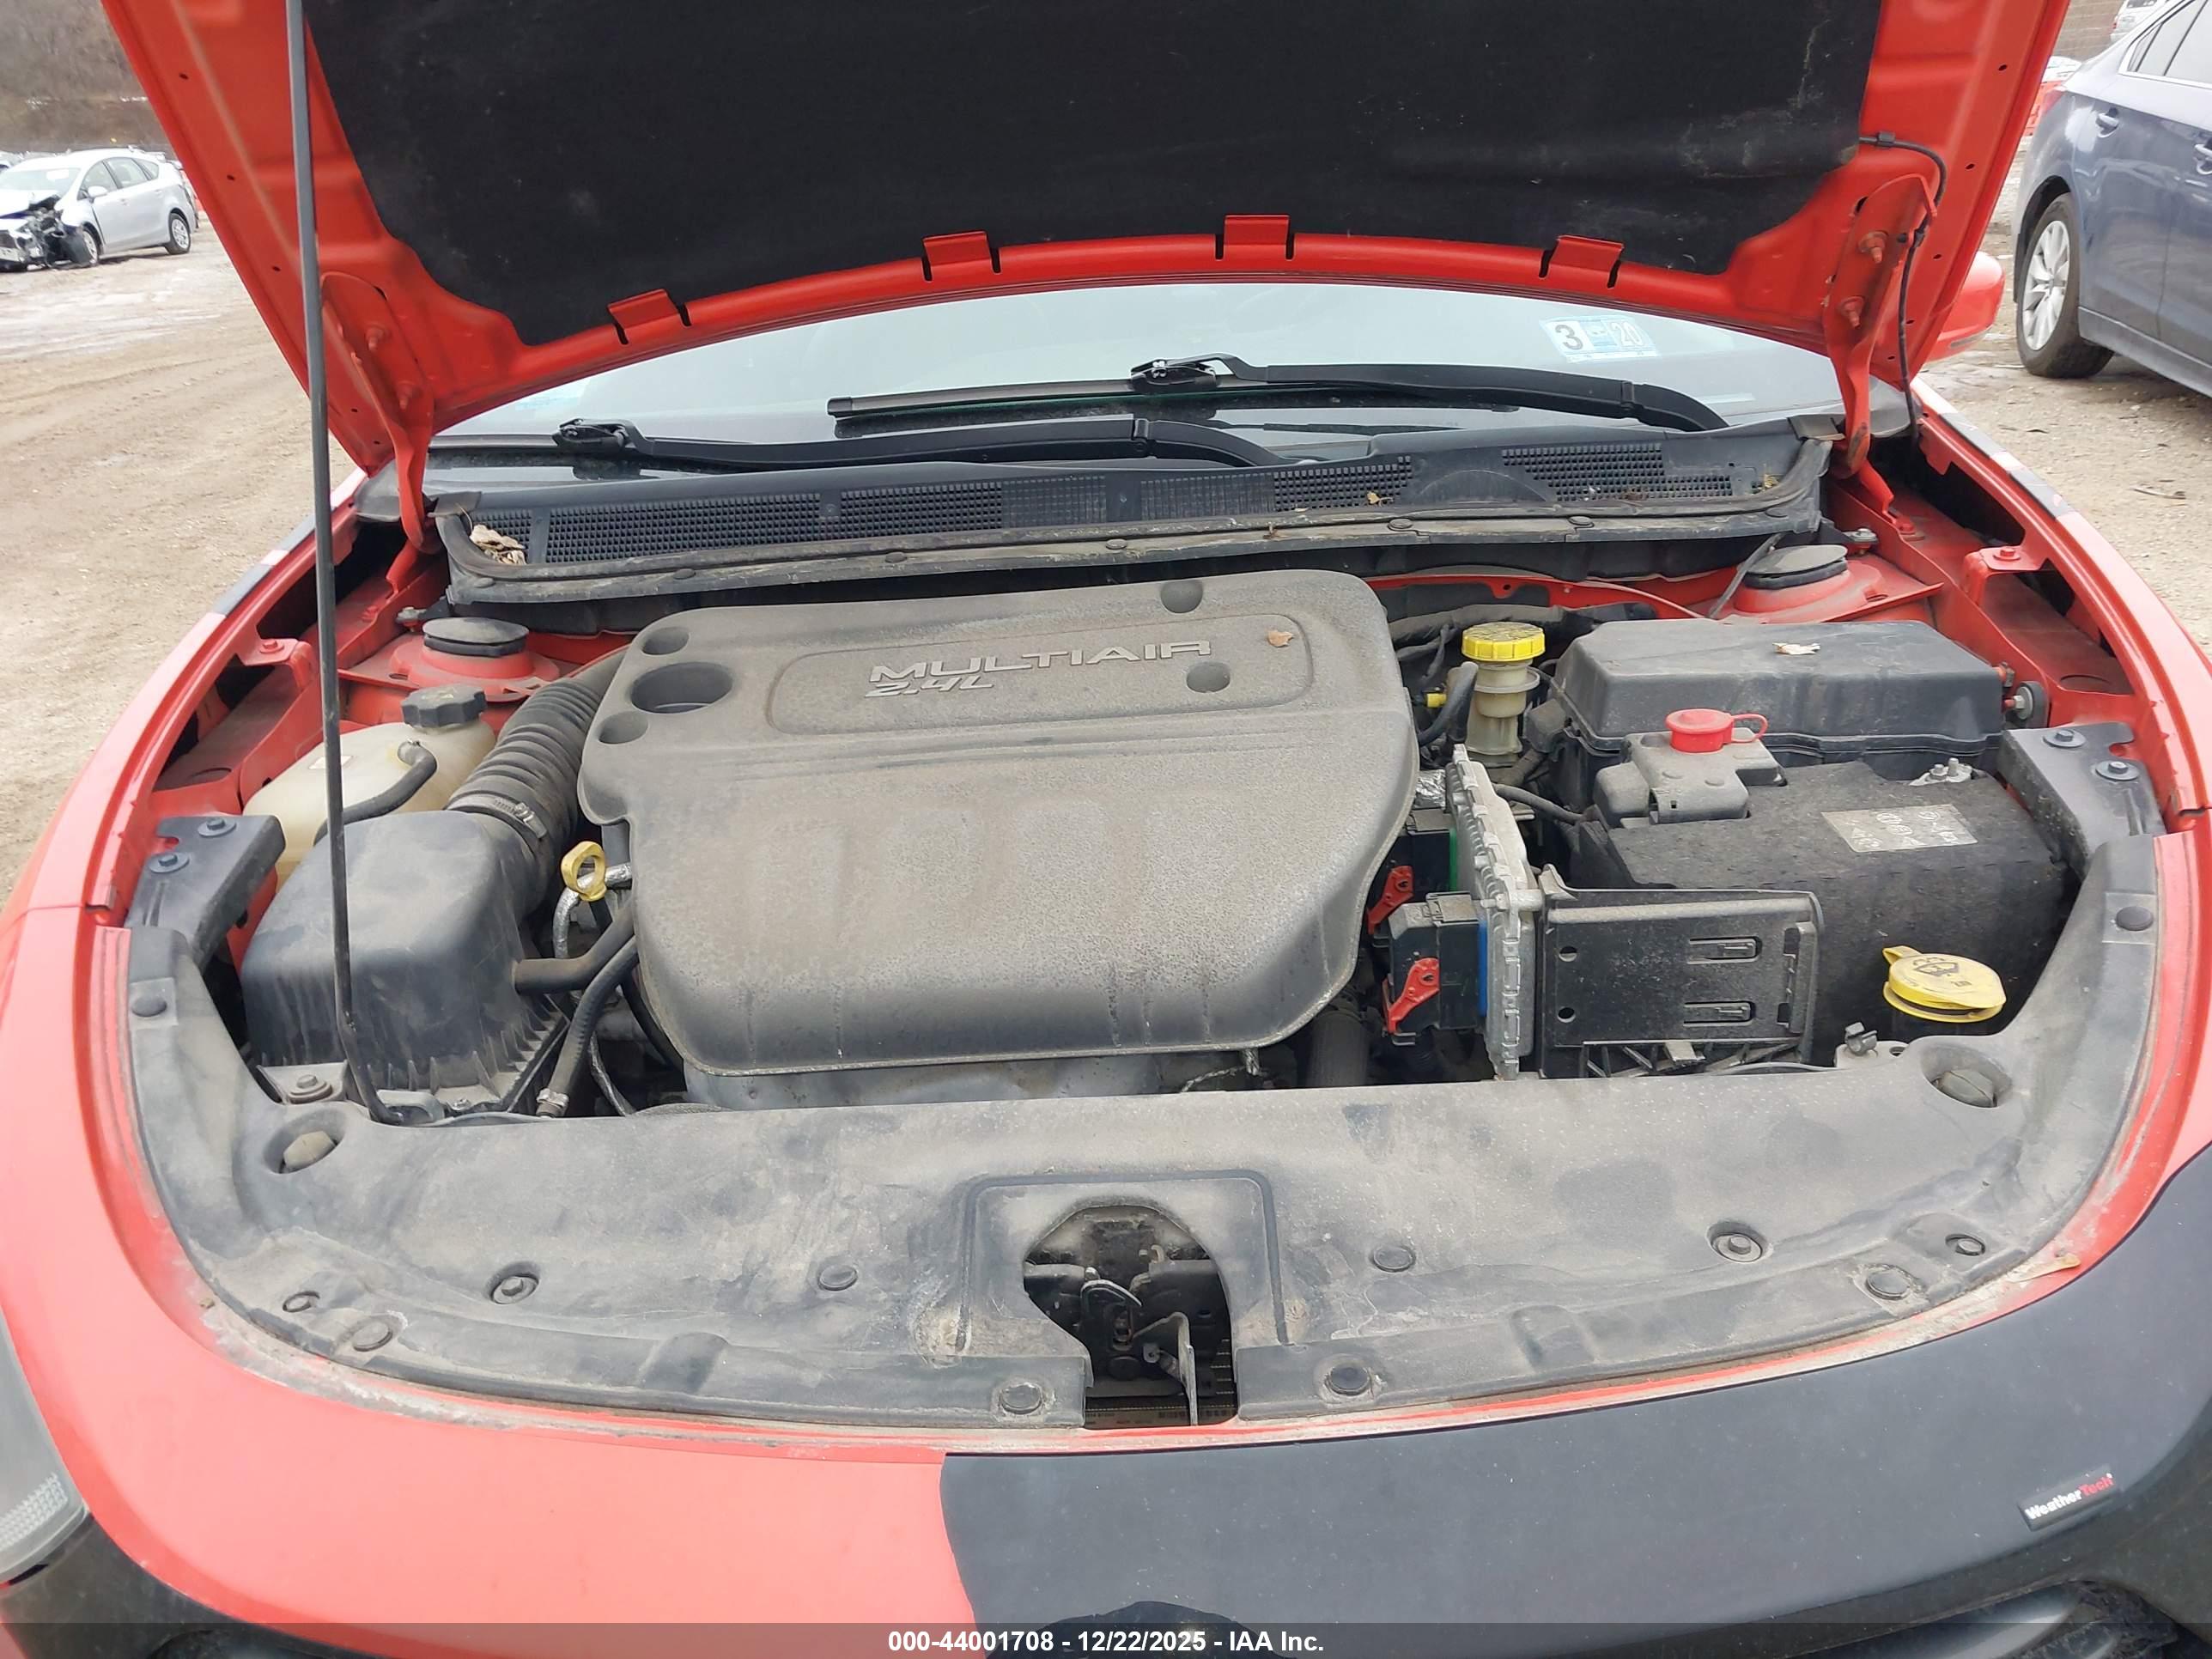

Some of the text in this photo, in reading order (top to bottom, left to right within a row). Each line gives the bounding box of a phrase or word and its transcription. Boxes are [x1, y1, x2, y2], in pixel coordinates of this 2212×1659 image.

[1556, 325, 1583, 350] 3
[870, 640, 1211, 682] MULTIAIR
[864, 678, 994, 698] 2.4L
